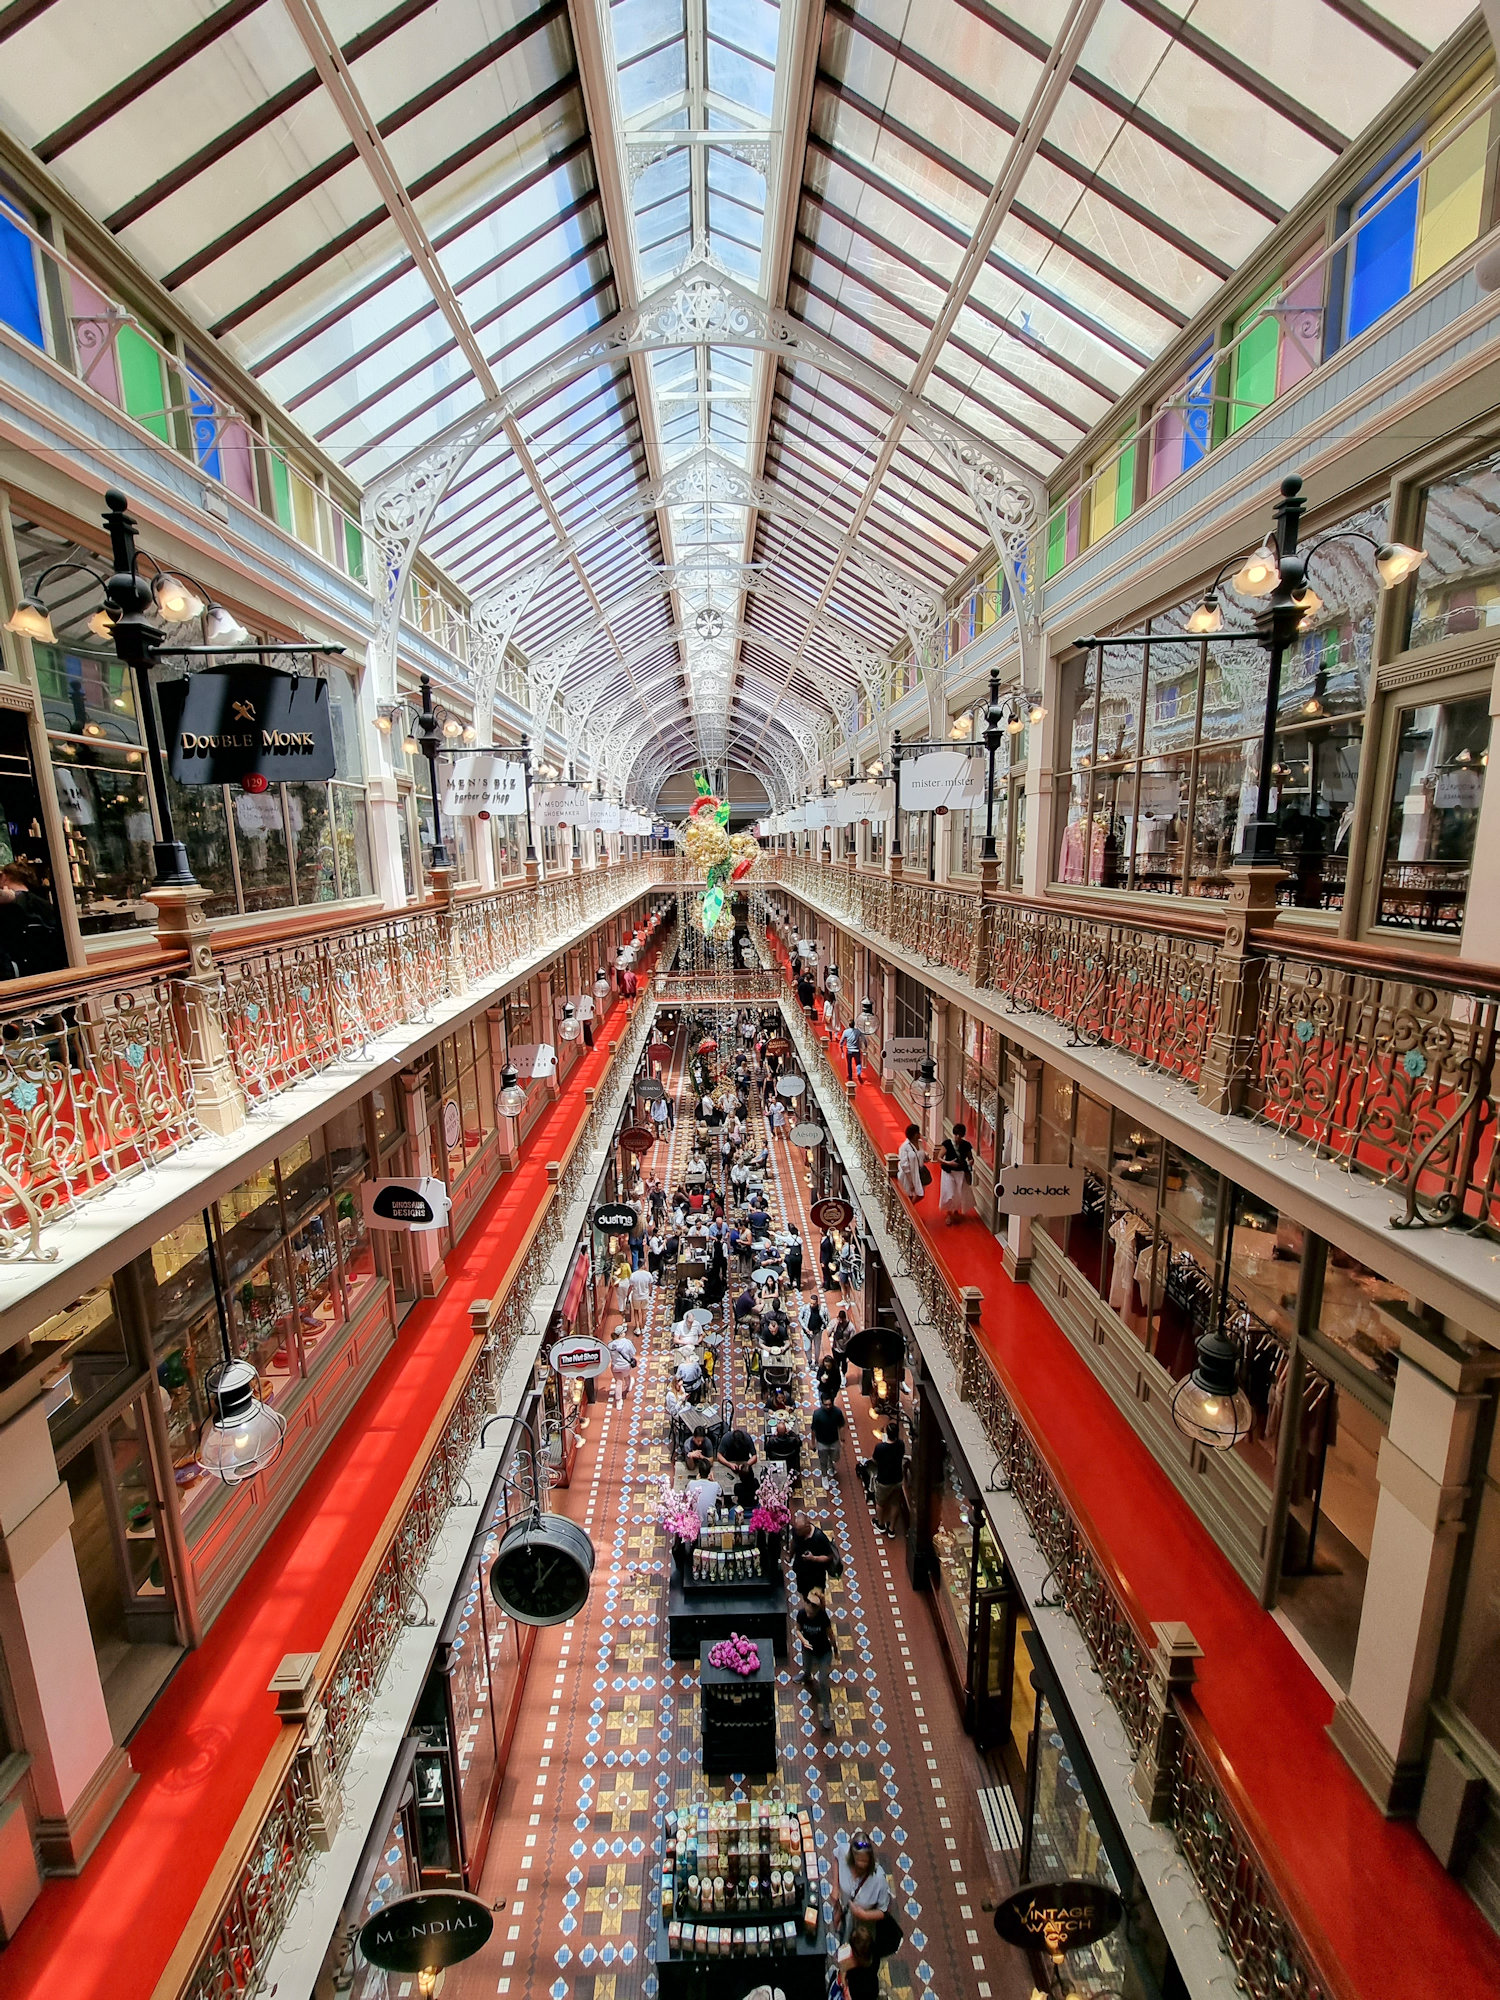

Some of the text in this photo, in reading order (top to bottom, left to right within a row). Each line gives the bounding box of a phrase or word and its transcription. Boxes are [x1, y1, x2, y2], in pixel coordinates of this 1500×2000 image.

[181, 729, 315, 749] DOUBLE MONK
[246, 777, 263, 788] 129
[447, 779, 516, 788] MEN'S BIZ
[454, 792, 479, 802] barber
[796, 1130, 818, 1139] Aesop
[1012, 1185, 1071, 1196] Jac+Jack
[392, 1201, 425, 1209] DINOSAUR
[393, 1209, 426, 1217] DESIGNS
[584, 1353, 598, 1361] Shop
[1011, 1898, 1096, 1924] VINTAGE
[376, 1915, 478, 1944] MONDIAL
[1026, 1919, 1091, 1933] WATCH
